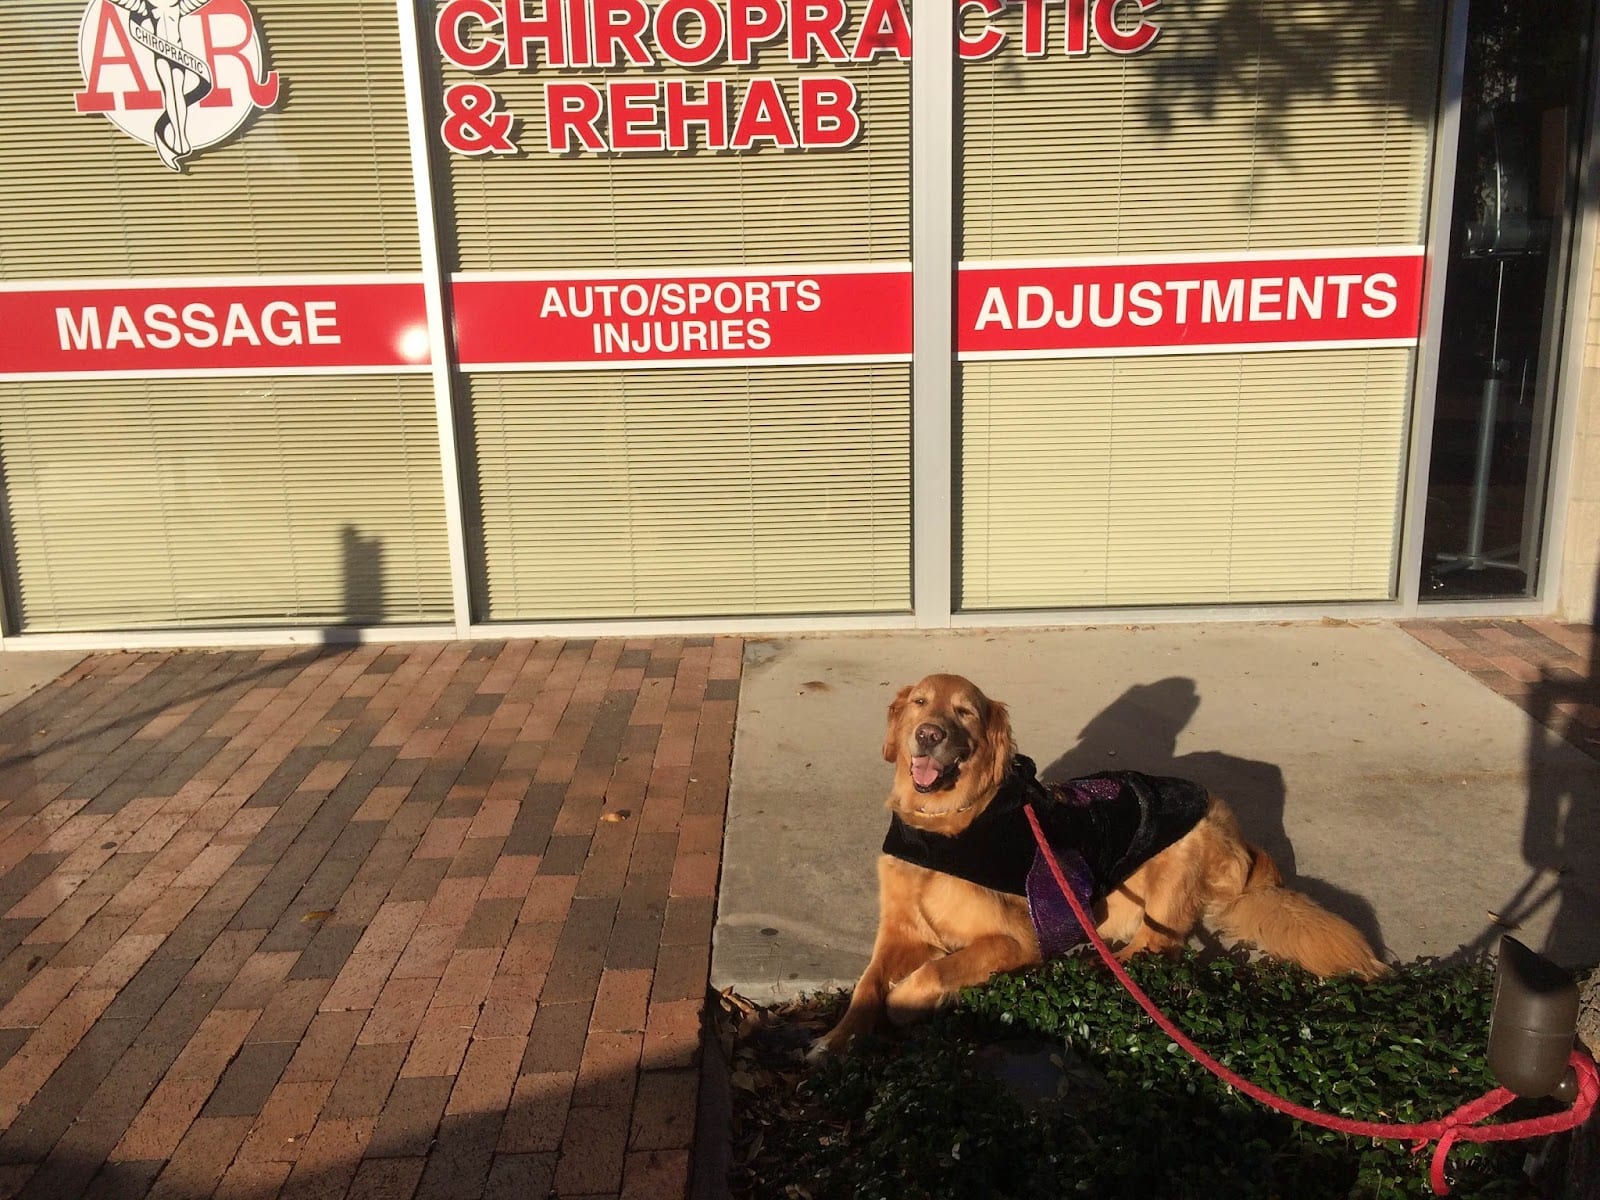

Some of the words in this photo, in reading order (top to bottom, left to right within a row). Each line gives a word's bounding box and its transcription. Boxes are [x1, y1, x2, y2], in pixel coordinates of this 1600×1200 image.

[134, 25, 204, 74] CHIROPRACTIC
[442, 83, 518, 156] &
[546, 76, 863, 153] REHAB
[539, 279, 822, 320] AUTO/SPORTS
[974, 272, 1399, 332] ADJUSTMENTS
[56, 300, 342, 351] MASSAGE
[592, 318, 772, 355] INJURIES
